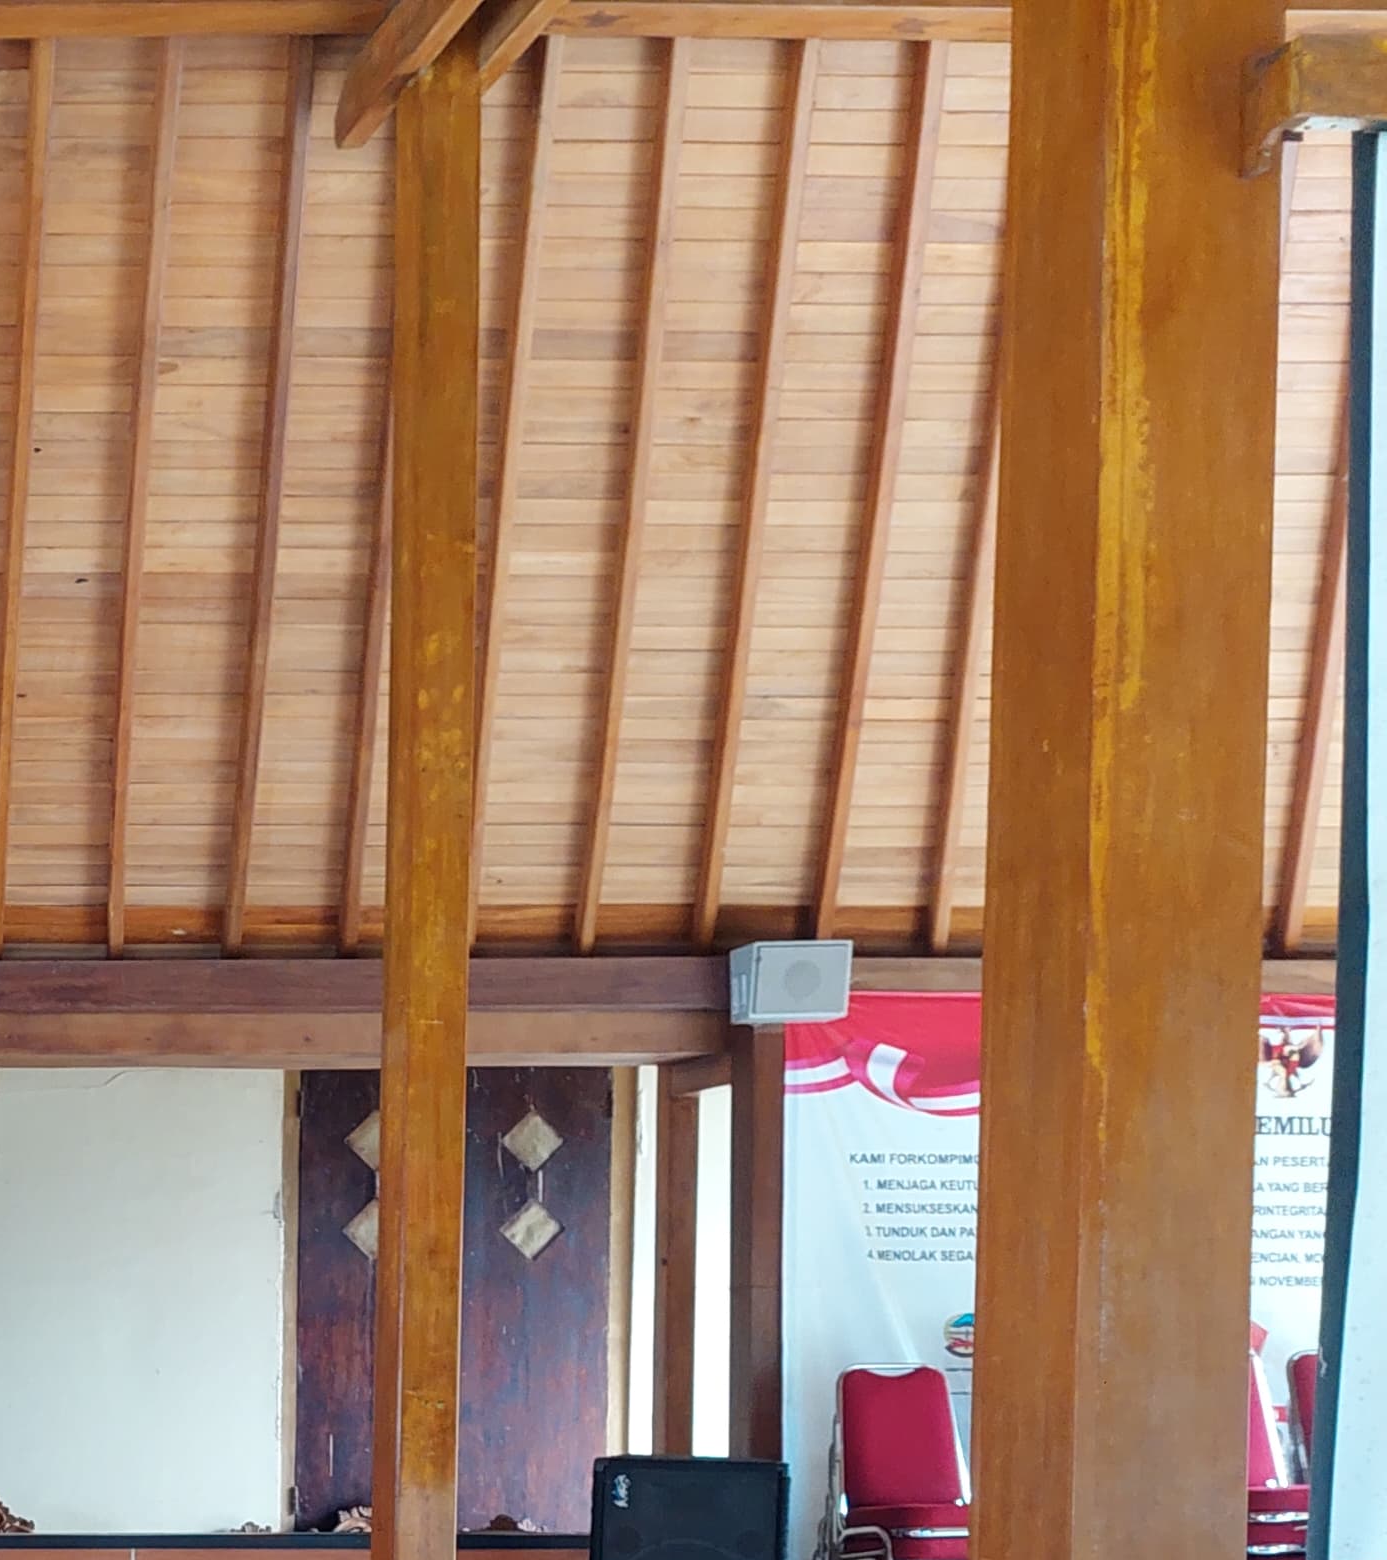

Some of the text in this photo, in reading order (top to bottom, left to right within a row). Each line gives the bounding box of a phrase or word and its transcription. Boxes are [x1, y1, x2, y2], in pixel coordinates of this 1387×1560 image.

[1255, 1116, 1331, 1136] EMILU
[849, 1153, 886, 1165] KAMI
[1273, 1156, 1327, 1167] PESERT
[876, 1179, 938, 1191] MENJAGA
[875, 1226, 928, 1238] TUNDUK
[930, 1226, 956, 1238] DAN
[959, 1226, 975, 1238] PA
[876, 1249, 938, 1262] MENOLAK
[940, 1249, 975, 1262] SEGA
[1259, 1275, 1323, 1287] NOVEMBE
